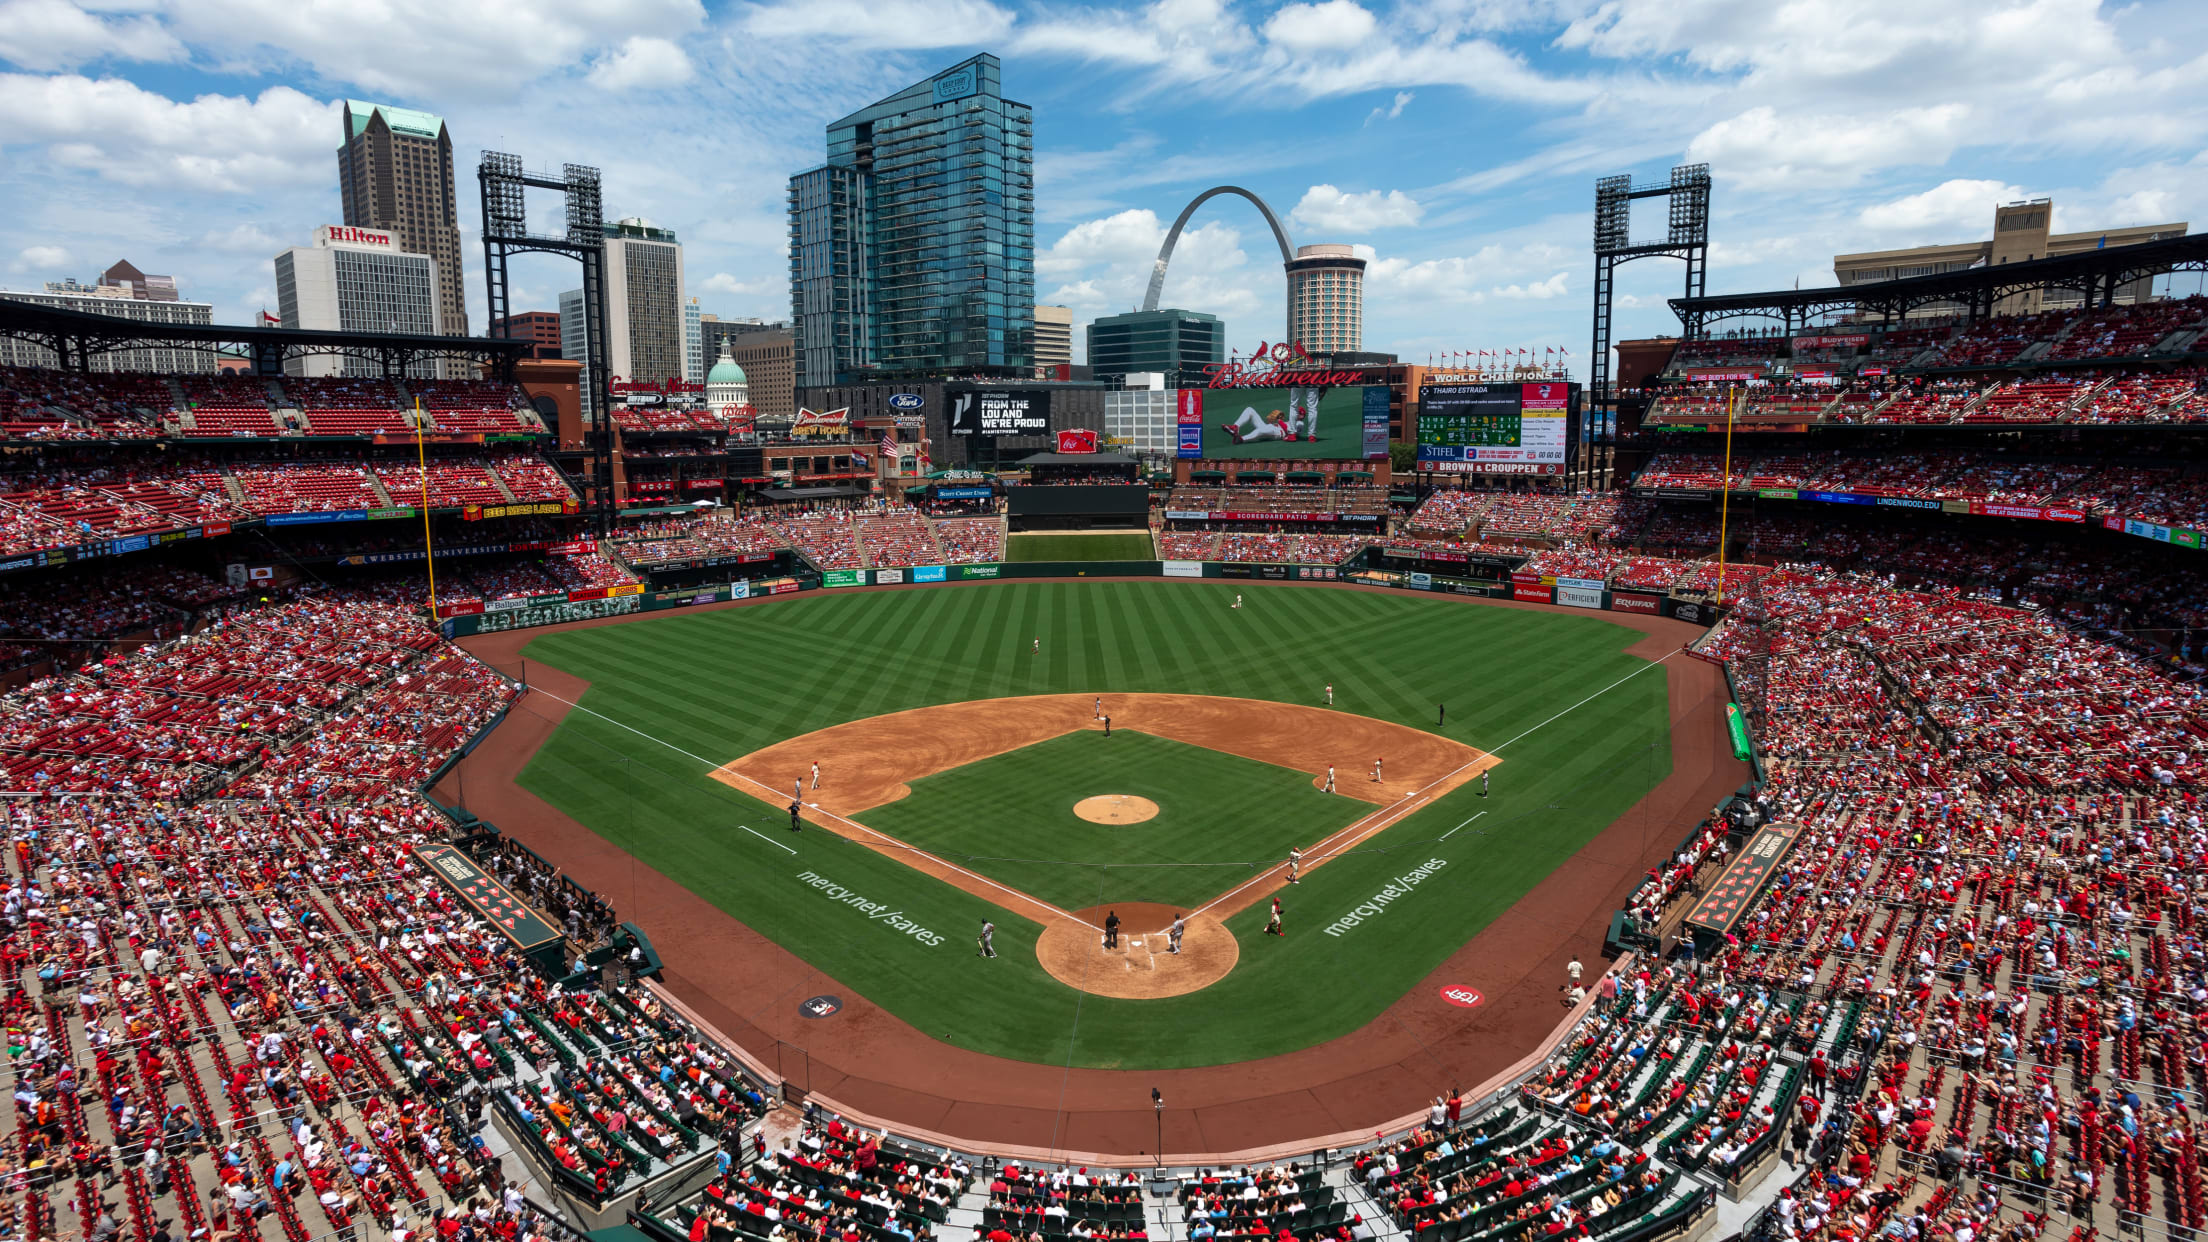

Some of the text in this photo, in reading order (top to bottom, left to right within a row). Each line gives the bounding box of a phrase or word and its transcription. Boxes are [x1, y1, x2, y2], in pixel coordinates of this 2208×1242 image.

[329, 227, 390, 244] Hilton
[1822, 336, 1865, 344] BUDWEISER
[1202, 363, 1363, 389] Budweiser
[1434, 371, 1552, 382] WORLD CHAMPIONS
[608, 375, 704, 396] Cardinals Nation
[896, 395, 919, 407] Ford
[981, 400, 1029, 409] FROM THE
[981, 409, 1023, 418] LOU AND
[981, 418, 1046, 428] WE'RE PROUD
[792, 425, 849, 435] BREW HOUSE
[1426, 446, 1456, 457] STIFEL
[1440, 463, 1474, 471] BROWN
[1485, 463, 1538, 473] CROUPPEN
[1877, 497, 1940, 510] LINDENWOOD.EDU
[483, 503, 562, 518] BIG MAC LAND
[2049, 510, 2083, 521] Dierbergs
[434, 545, 505, 557] UNIVERSITY
[369, 551, 427, 563] WEBSTER
[971, 566, 998, 574] National
[615, 585, 638, 594] DOBBS
[1558, 591, 1599, 604] PERFICIENT
[494, 598, 528, 609] Ballpark
[1614, 598, 1656, 609] EQUIFAX
[1323, 857, 1448, 937] mercy.net/saves
[796, 870, 946, 946] mercy.net/saves
